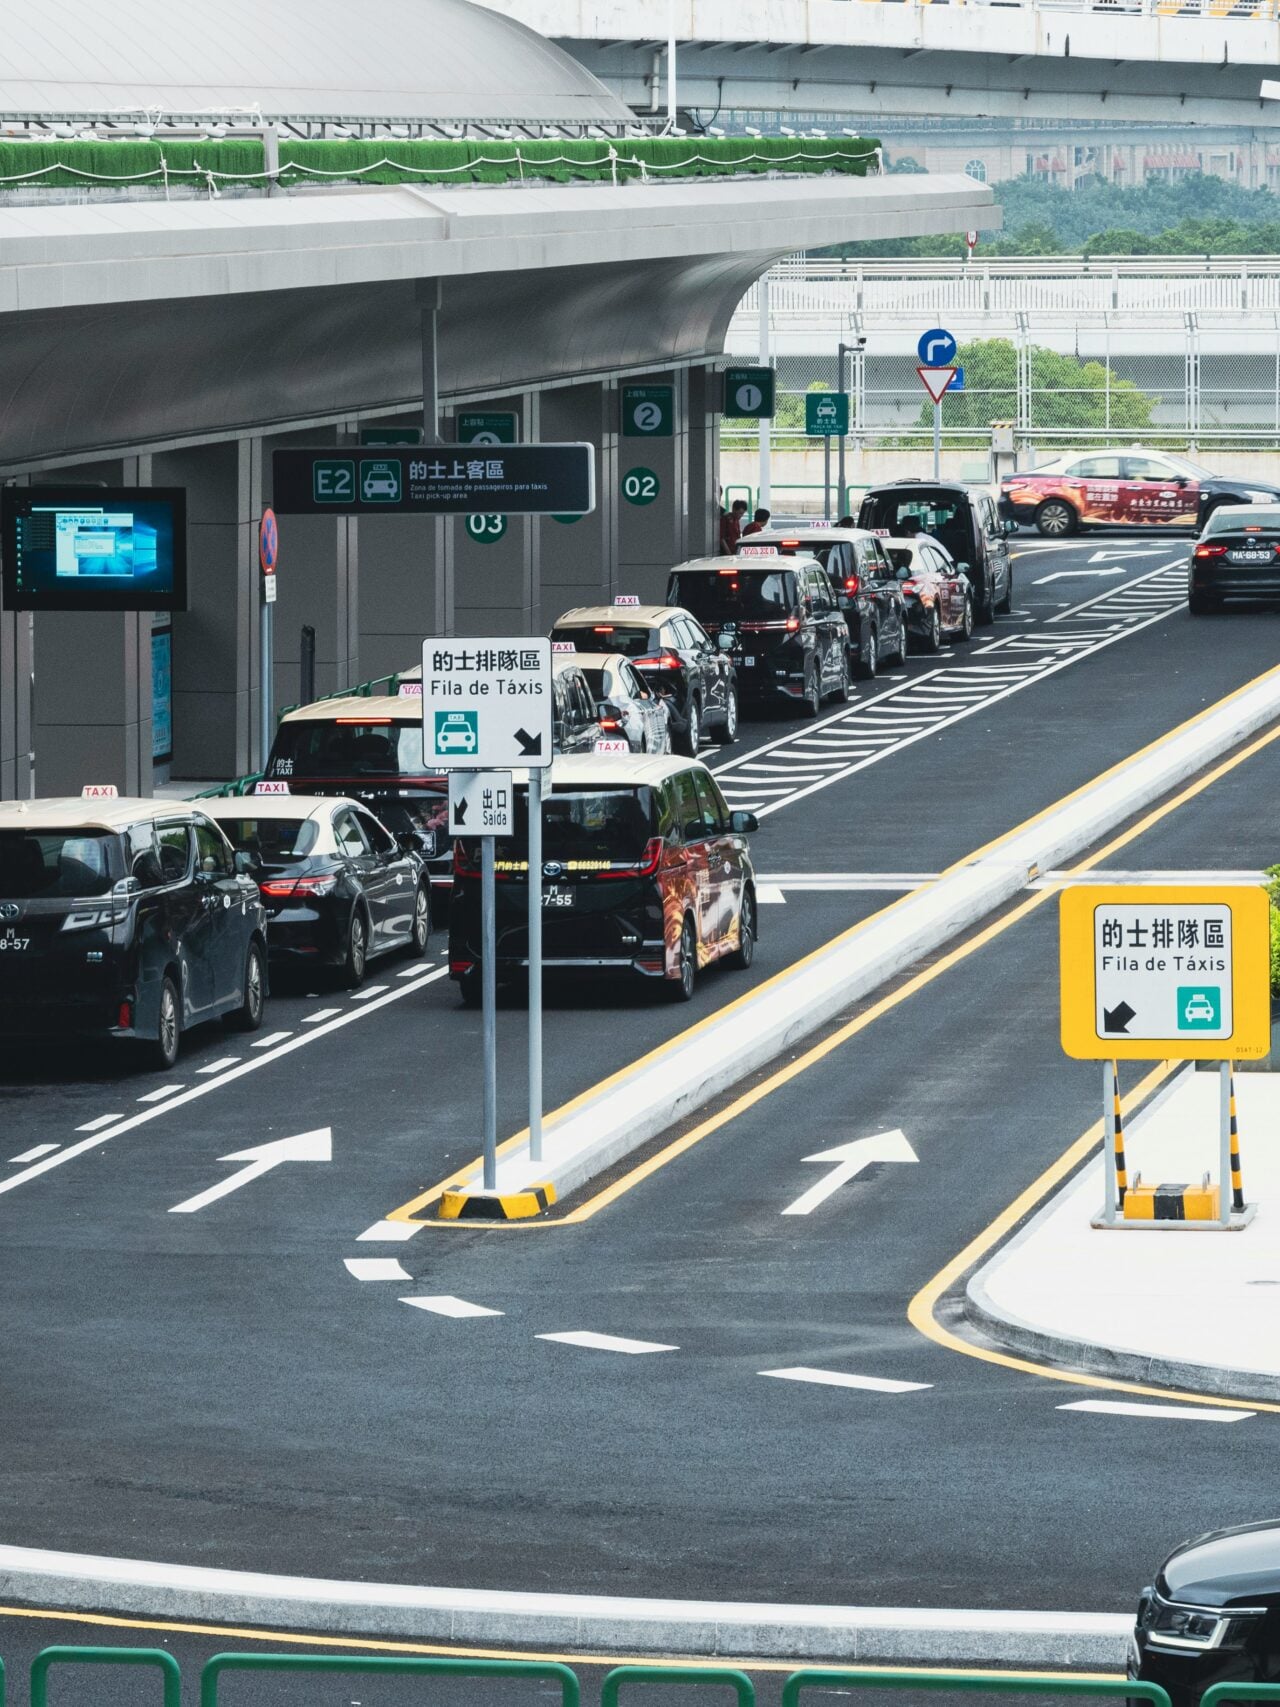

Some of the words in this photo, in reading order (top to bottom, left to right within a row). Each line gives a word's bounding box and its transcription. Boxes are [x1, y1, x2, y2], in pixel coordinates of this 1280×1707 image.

[745, 388, 752, 407] 1
[640, 406, 656, 426] 2
[408, 460, 504, 480] 的士上客區
[316, 468, 351, 494] E2
[474, 484, 514, 492] passageiros
[514, 484, 529, 492] para
[625, 476, 656, 497] 02
[410, 492, 424, 500] Taxi
[426, 492, 451, 500] pick-up
[470, 515, 503, 534] 03
[742, 547, 774, 555] TAXI
[432, 650, 540, 672] 的士排隊區
[403, 685, 422, 695] TA
[431, 680, 462, 696] Fila
[469, 680, 490, 696] de
[496, 678, 543, 695] Táxis
[598, 742, 626, 752] TAXI
[276, 758, 294, 768] 的士
[276, 768, 293, 776] TAXI
[85, 787, 113, 796] TAXI
[258, 784, 284, 792] TAXI
[482, 788, 507, 810] 出口
[483, 810, 507, 826] Saída
[550, 885, 558, 895] M
[540, 894, 572, 906] 7-55
[6, 928, 15, 939] M
[1102, 918, 1224, 948] 的士排隊區
[1102, 956, 1139, 971] Fila
[1145, 956, 1166, 971] de
[1173, 955, 1226, 971] Táxis
